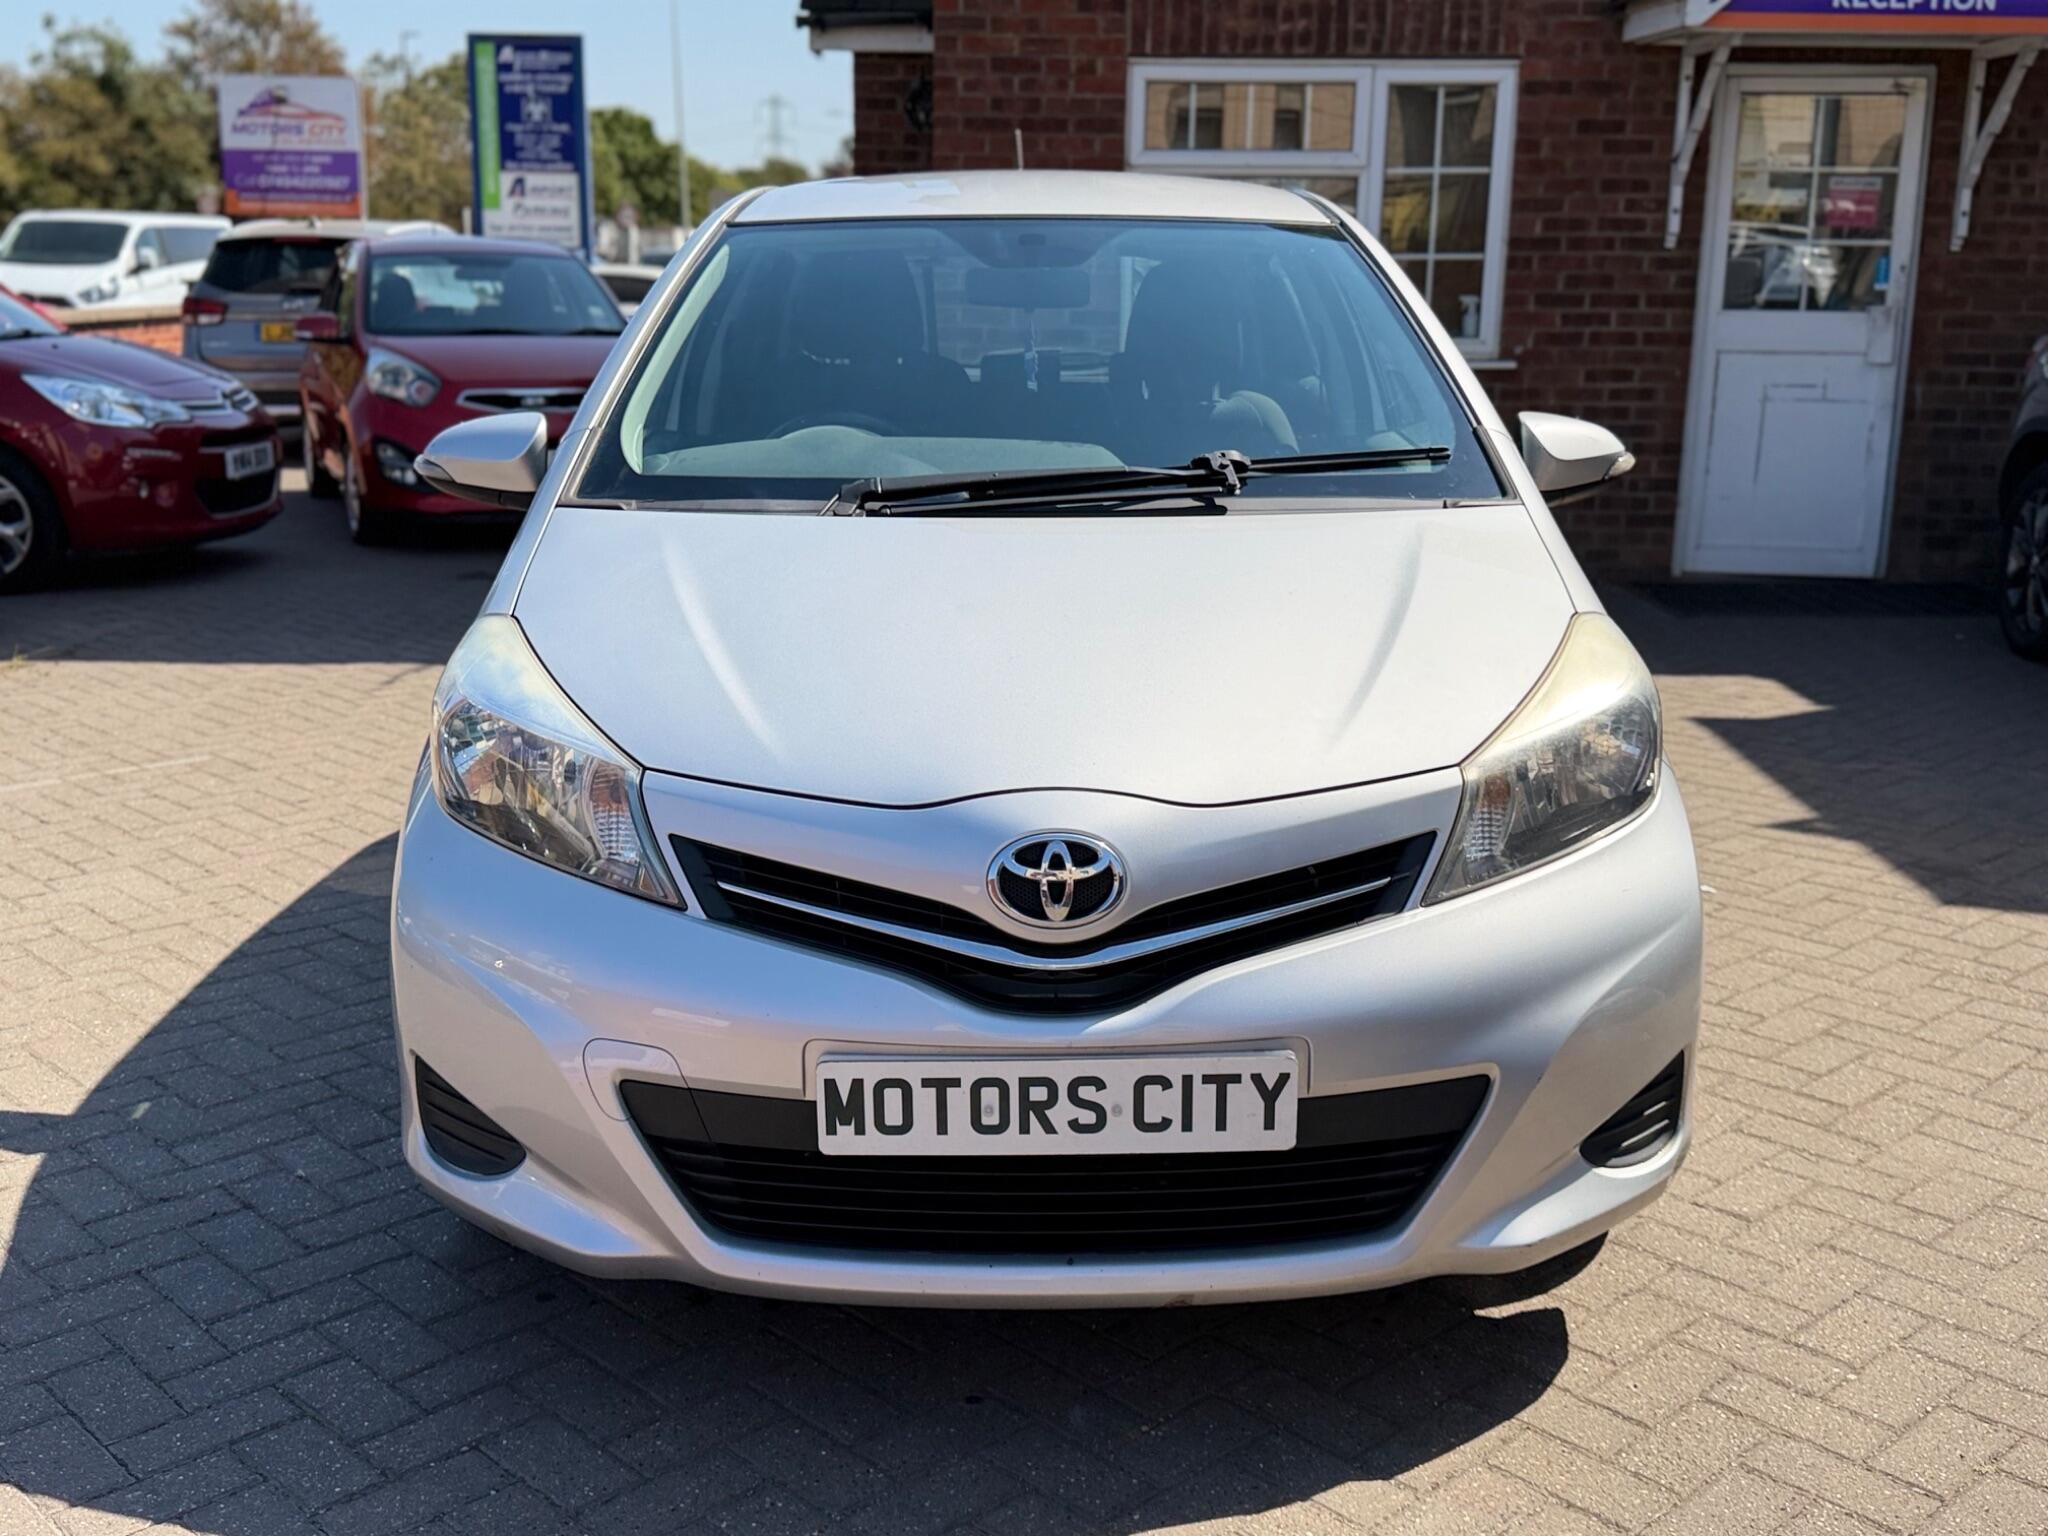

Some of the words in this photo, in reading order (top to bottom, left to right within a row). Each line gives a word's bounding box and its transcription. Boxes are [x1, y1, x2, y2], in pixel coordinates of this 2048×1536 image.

[231, 122, 304, 135] MOTORS
[308, 123, 346, 136] CITY
[823, 1075, 1107, 1136] MOTORS
[1133, 1072, 1291, 1133] CITY
